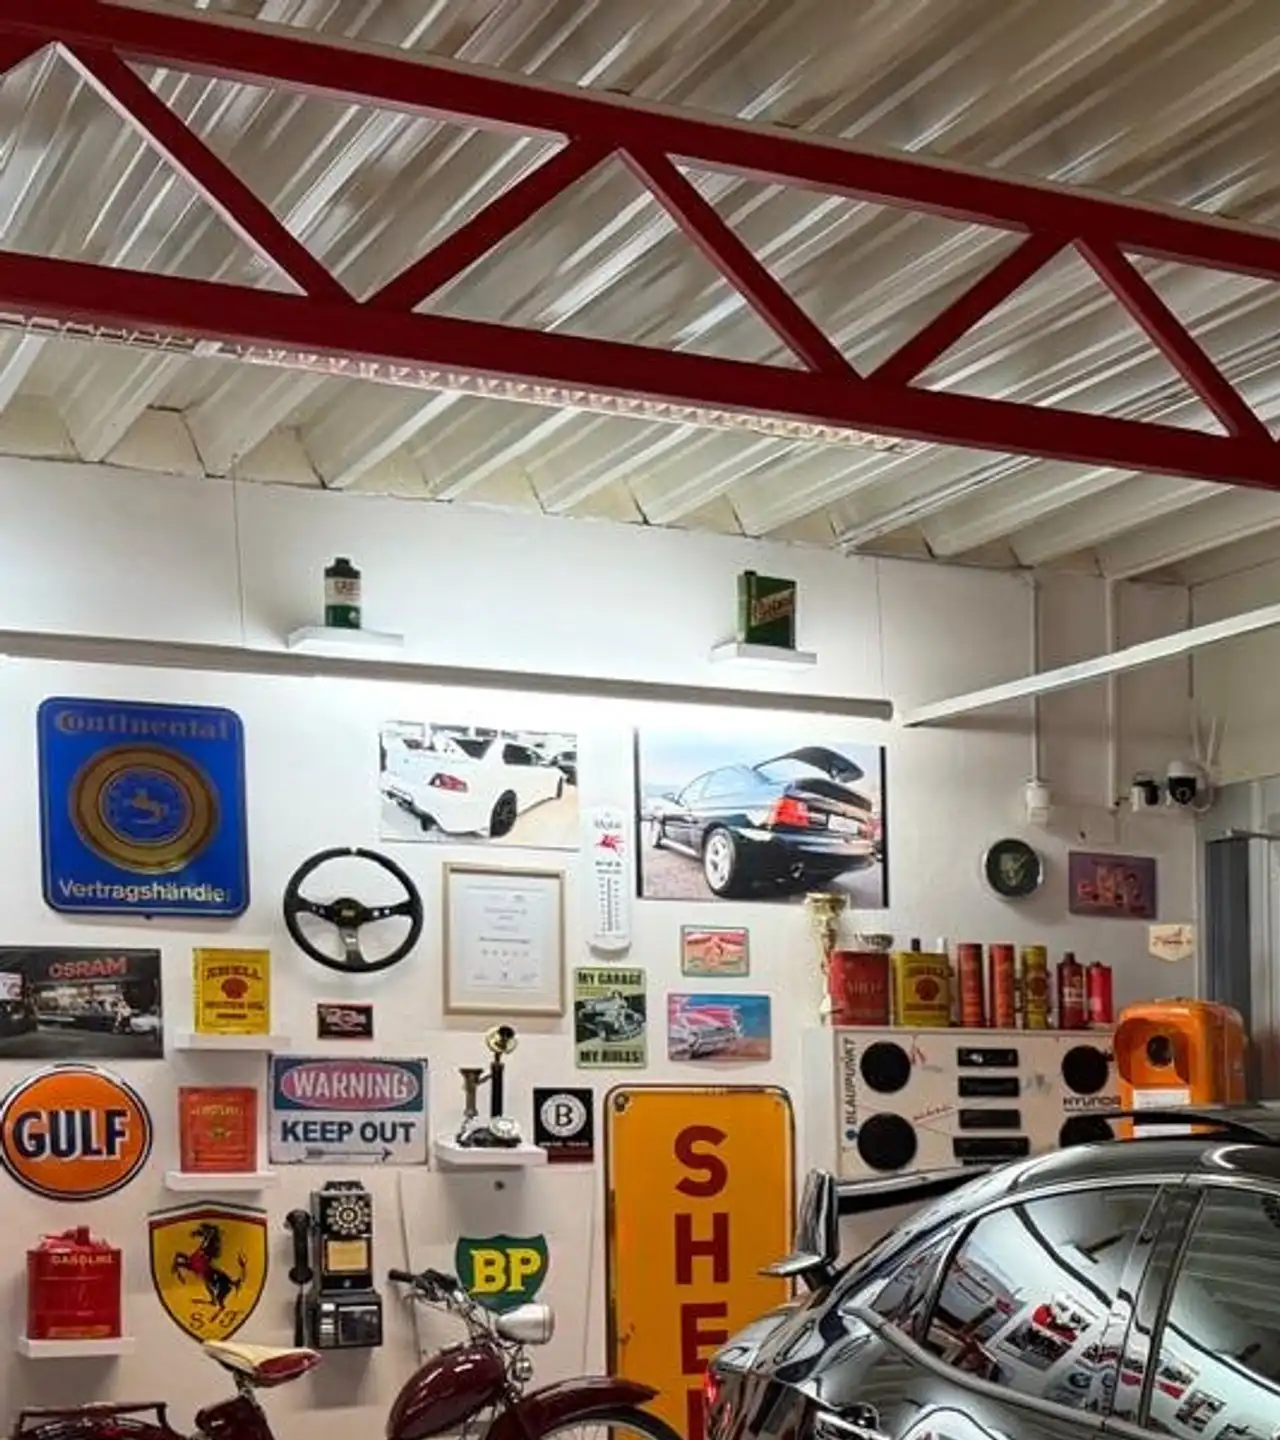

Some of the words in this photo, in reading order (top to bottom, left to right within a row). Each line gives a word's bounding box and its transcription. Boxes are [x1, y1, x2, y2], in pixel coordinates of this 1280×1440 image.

[55, 708, 230, 741] Continental
[48, 956, 128, 979] OSRAM
[577, 971, 597, 984] MY
[598, 972, 642, 985] GARAGE
[580, 1050, 599, 1062] MY
[291, 1062, 411, 1101] WARNING
[843, 1037, 858, 1126] BLAUPUNKT
[555, 1103, 573, 1127] B
[13, 1108, 131, 1161] GULF
[281, 1119, 356, 1145] KEEP
[359, 1119, 417, 1145] OUT
[470, 1248, 542, 1296] BP
